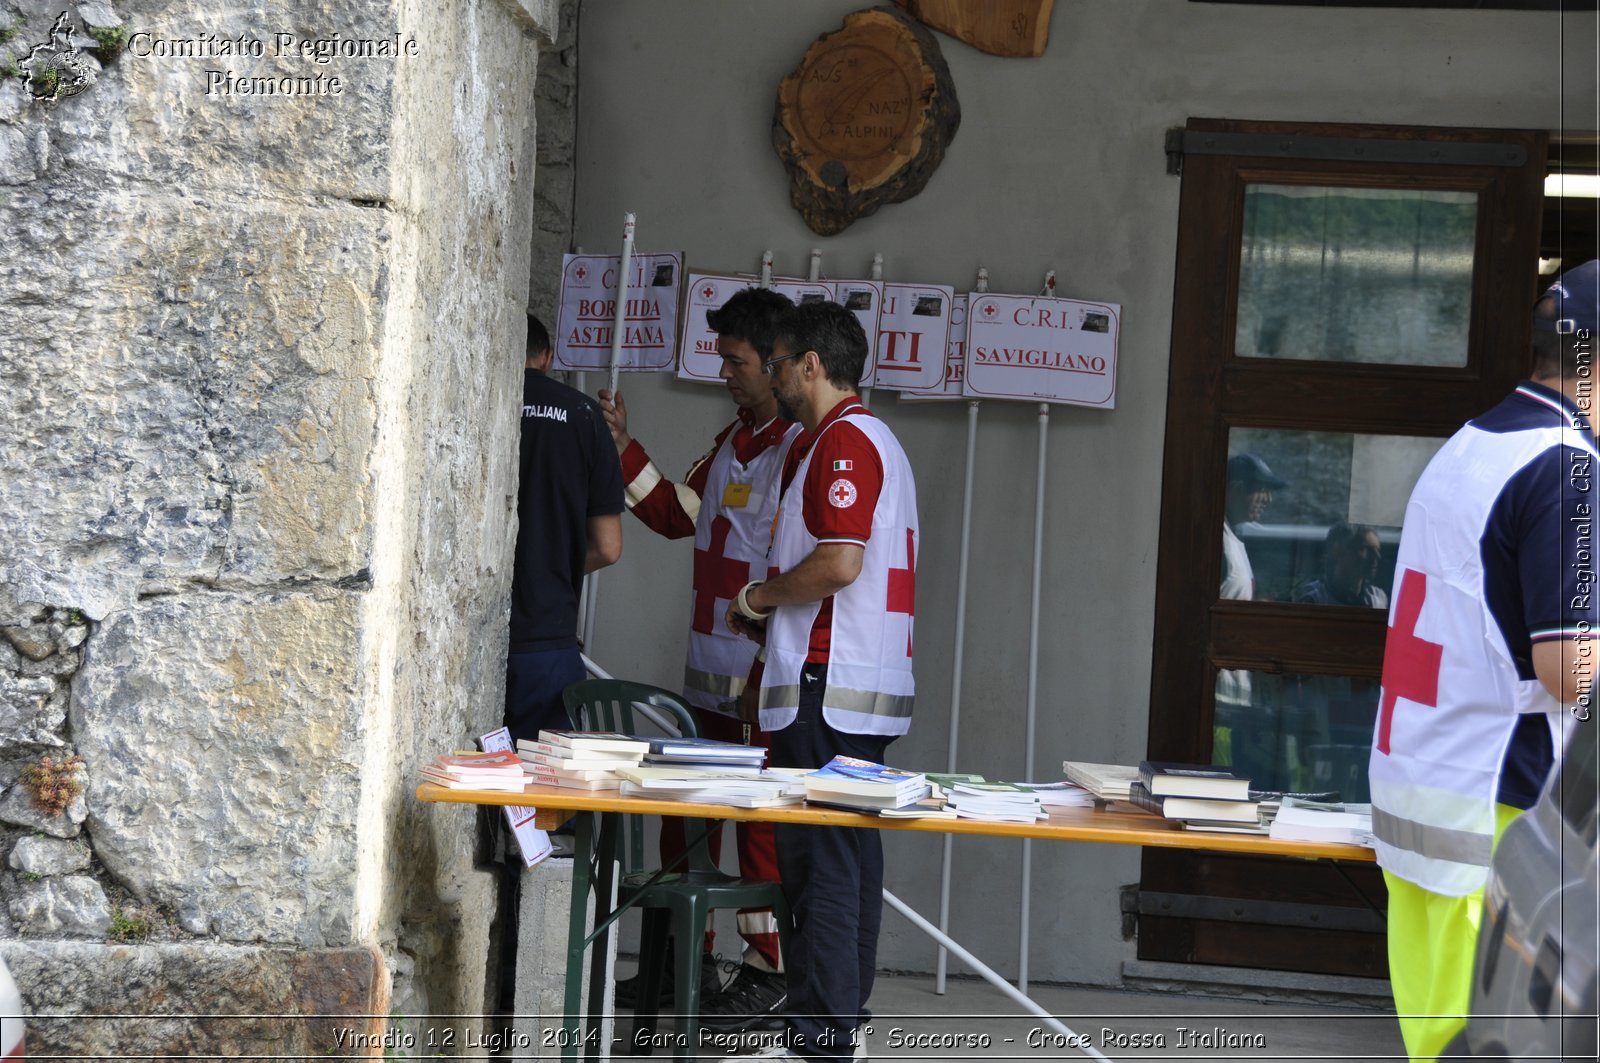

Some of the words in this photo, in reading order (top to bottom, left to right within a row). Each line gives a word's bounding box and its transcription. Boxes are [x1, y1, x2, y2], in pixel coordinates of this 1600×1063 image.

[601, 267, 648, 289] C..I.
[1013, 307, 1073, 331] C.R.I.
[568, 325, 665, 345] ASTIIANA
[975, 346, 1106, 373] SAVIGLIANO
[523, 404, 567, 423] TALIANA
